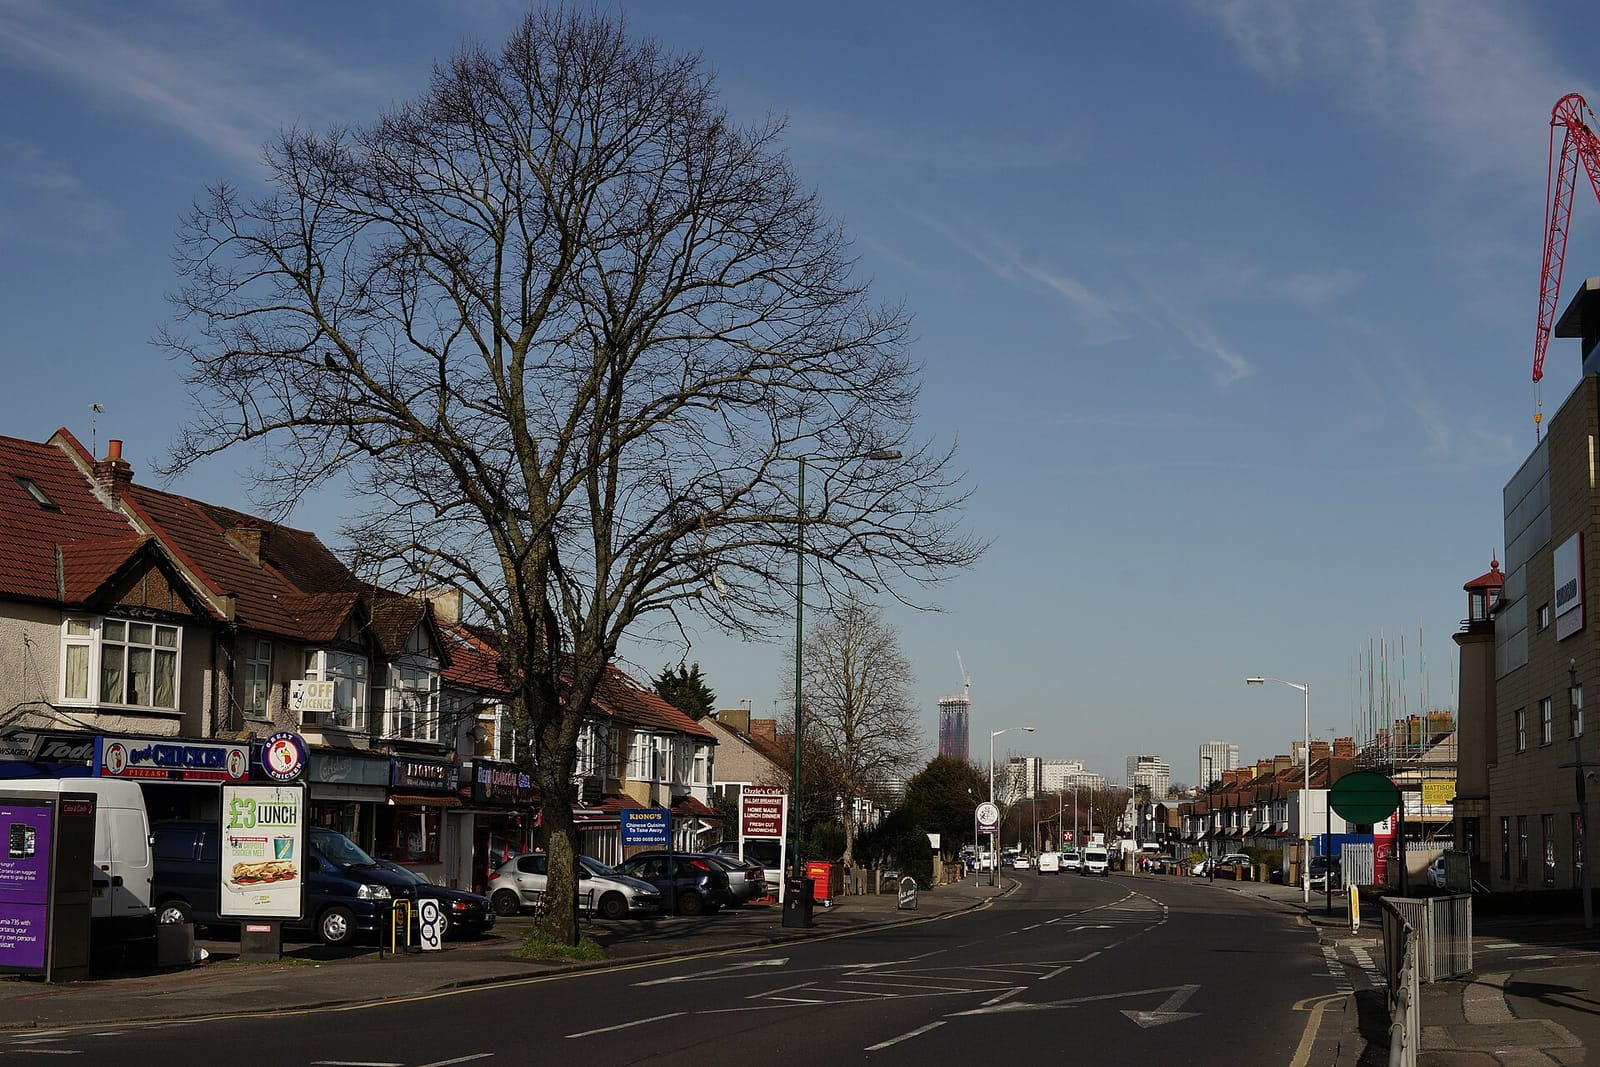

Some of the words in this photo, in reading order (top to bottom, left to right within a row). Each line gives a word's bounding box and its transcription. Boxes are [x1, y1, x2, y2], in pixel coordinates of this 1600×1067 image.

[308, 684, 333, 698] OFF
[266, 733, 294, 748] GREAT
[271, 762, 302, 779] CHICKEN
[230, 798, 256, 829] £3
[258, 806, 297, 824] LUNCH
